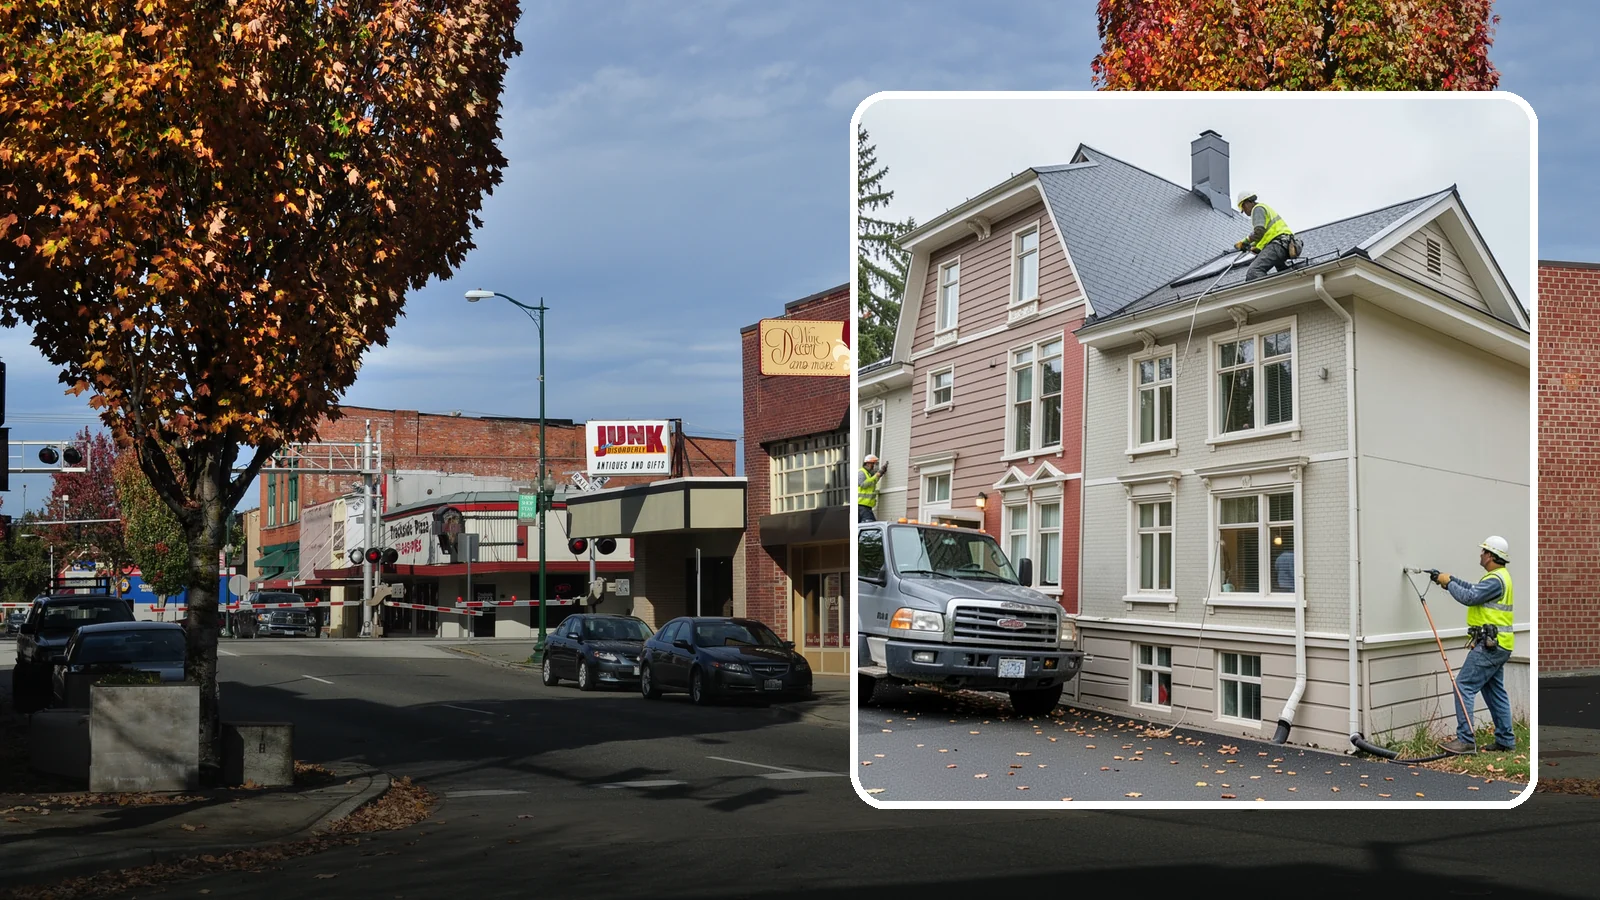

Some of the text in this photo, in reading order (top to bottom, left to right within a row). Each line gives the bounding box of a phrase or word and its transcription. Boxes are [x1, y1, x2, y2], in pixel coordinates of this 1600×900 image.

[595, 425, 666, 457] JUNK
[607, 446, 646, 454] DISORDERLY
[596, 460, 665, 470] ANTIQUES AND GIFTS
[390, 519, 429, 539] Trackside Pizza
